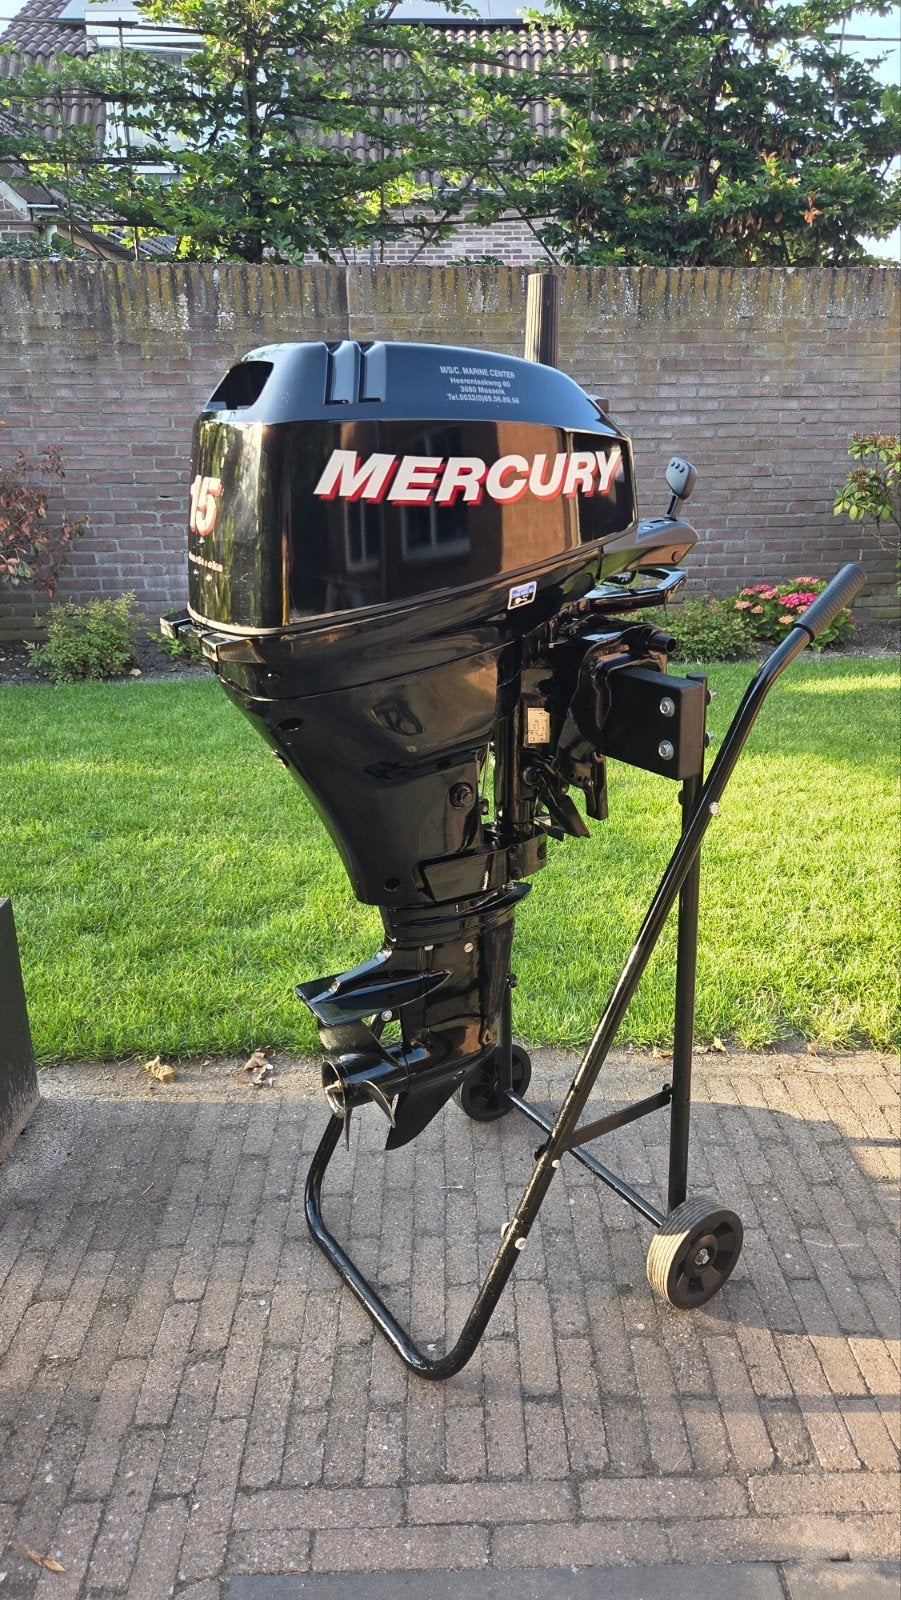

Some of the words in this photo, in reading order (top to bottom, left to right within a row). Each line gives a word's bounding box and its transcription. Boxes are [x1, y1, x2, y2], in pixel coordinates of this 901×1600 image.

[462, 367, 489, 376] MARINE
[489, 369, 516, 379] CENTER
[189, 475, 222, 536] 15
[313, 449, 623, 506] MERCURY
